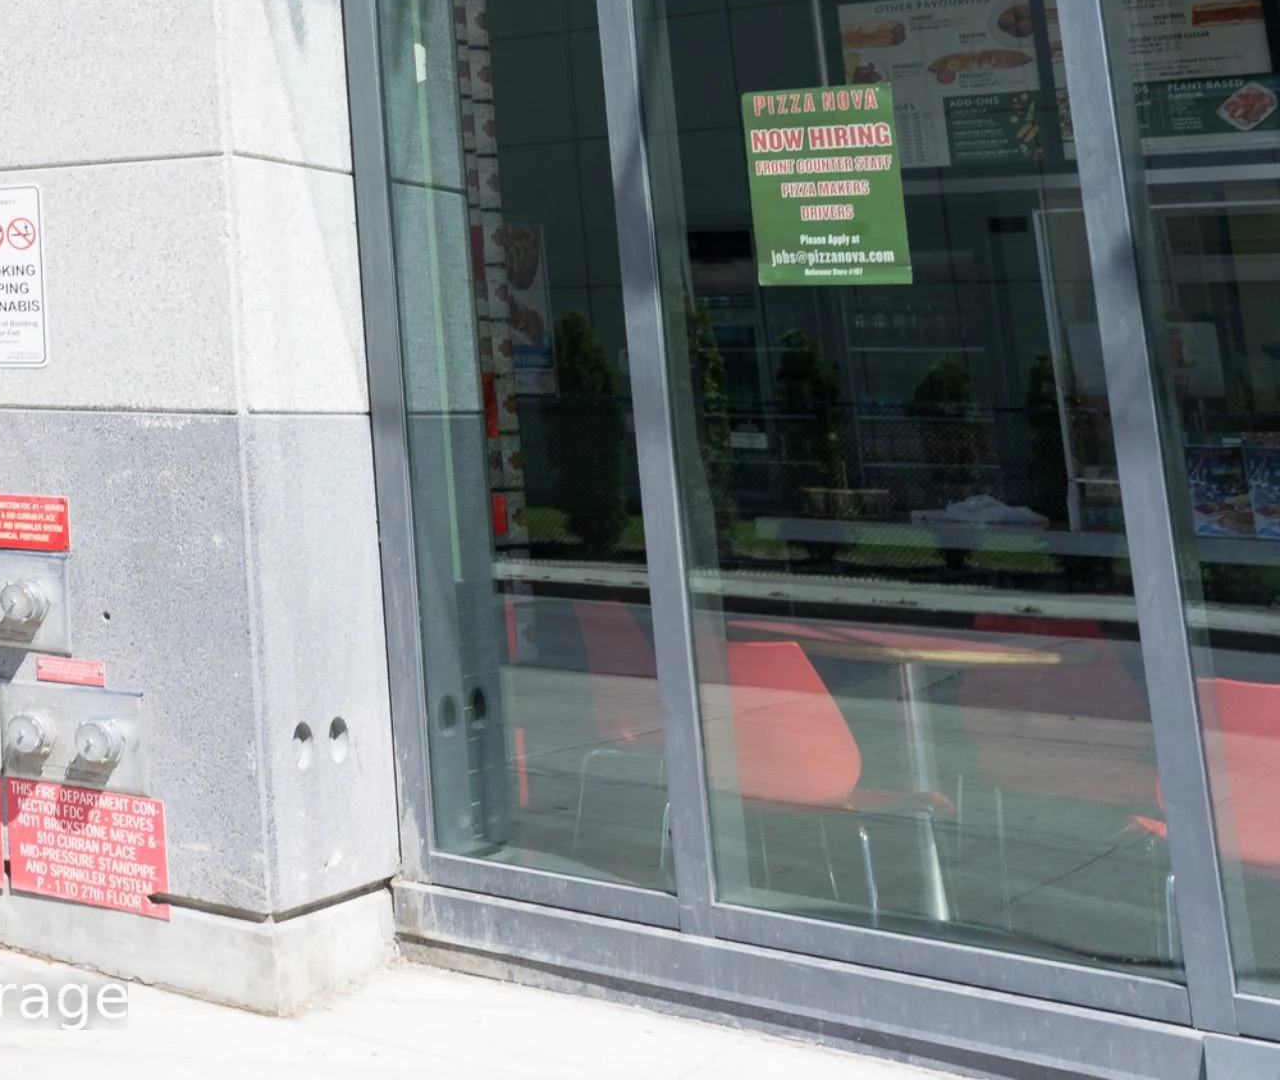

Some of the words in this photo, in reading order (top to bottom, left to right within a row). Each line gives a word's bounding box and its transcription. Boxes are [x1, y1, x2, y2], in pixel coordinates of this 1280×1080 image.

[875, 4, 912, 14] OTHER
[753, 93, 815, 117] PIZZA
[821, 88, 878, 111] NOVA
[750, 128, 804, 153] NOW
[808, 122, 892, 150] HIRING
[755, 159, 795, 176] FRONT
[796, 157, 853, 174] COUNTER
[854, 154, 892, 170] STAFF
[781, 182, 816, 198] PIZZA
[818, 180, 869, 196] MAKERS
[801, 204, 854, 221] DRIVERS
[800, 234, 826, 245] Please
[828, 234, 850, 246] Apply
[851, 234, 860, 244] at
[771, 249, 895, 267] jobs@pizzanova.com
[11, 781, 32, 795] THIS
[35, 785, 57, 799] FIRE
[59, 790, 128, 811] DEPARTMENT
[132, 800, 159, 815] CON-
[18, 797, 60, 815] NECTION
[64, 805, 84, 820] FDC
[88, 809, 101, 823] #2
[112, 814, 154, 832] SERVES
[17, 813, 40, 827] 4011
[44, 817, 108, 841] BRICKSTONE
[111, 826, 145, 846] MEWS
[148, 835, 156, 848] &
[37, 832, 54, 846] 510
[57, 835, 99, 853] CURRAN
[102, 844, 136, 860] PLACE
[20, 843, 95, 868] MID-PRESSURE
[99, 857, 156, 880] STANDPIPE
[26, 860, 47, 874] AND
[50, 864, 105, 886] SPRINKLER
[109, 875, 153, 894] SYSTEM
[37, 877, 44, 889] P
[55, 880, 60, 892] 1
[64, 882, 78, 896] TO
[82, 885, 104, 901] 27th
[107, 891, 141, 908] FLOOR
